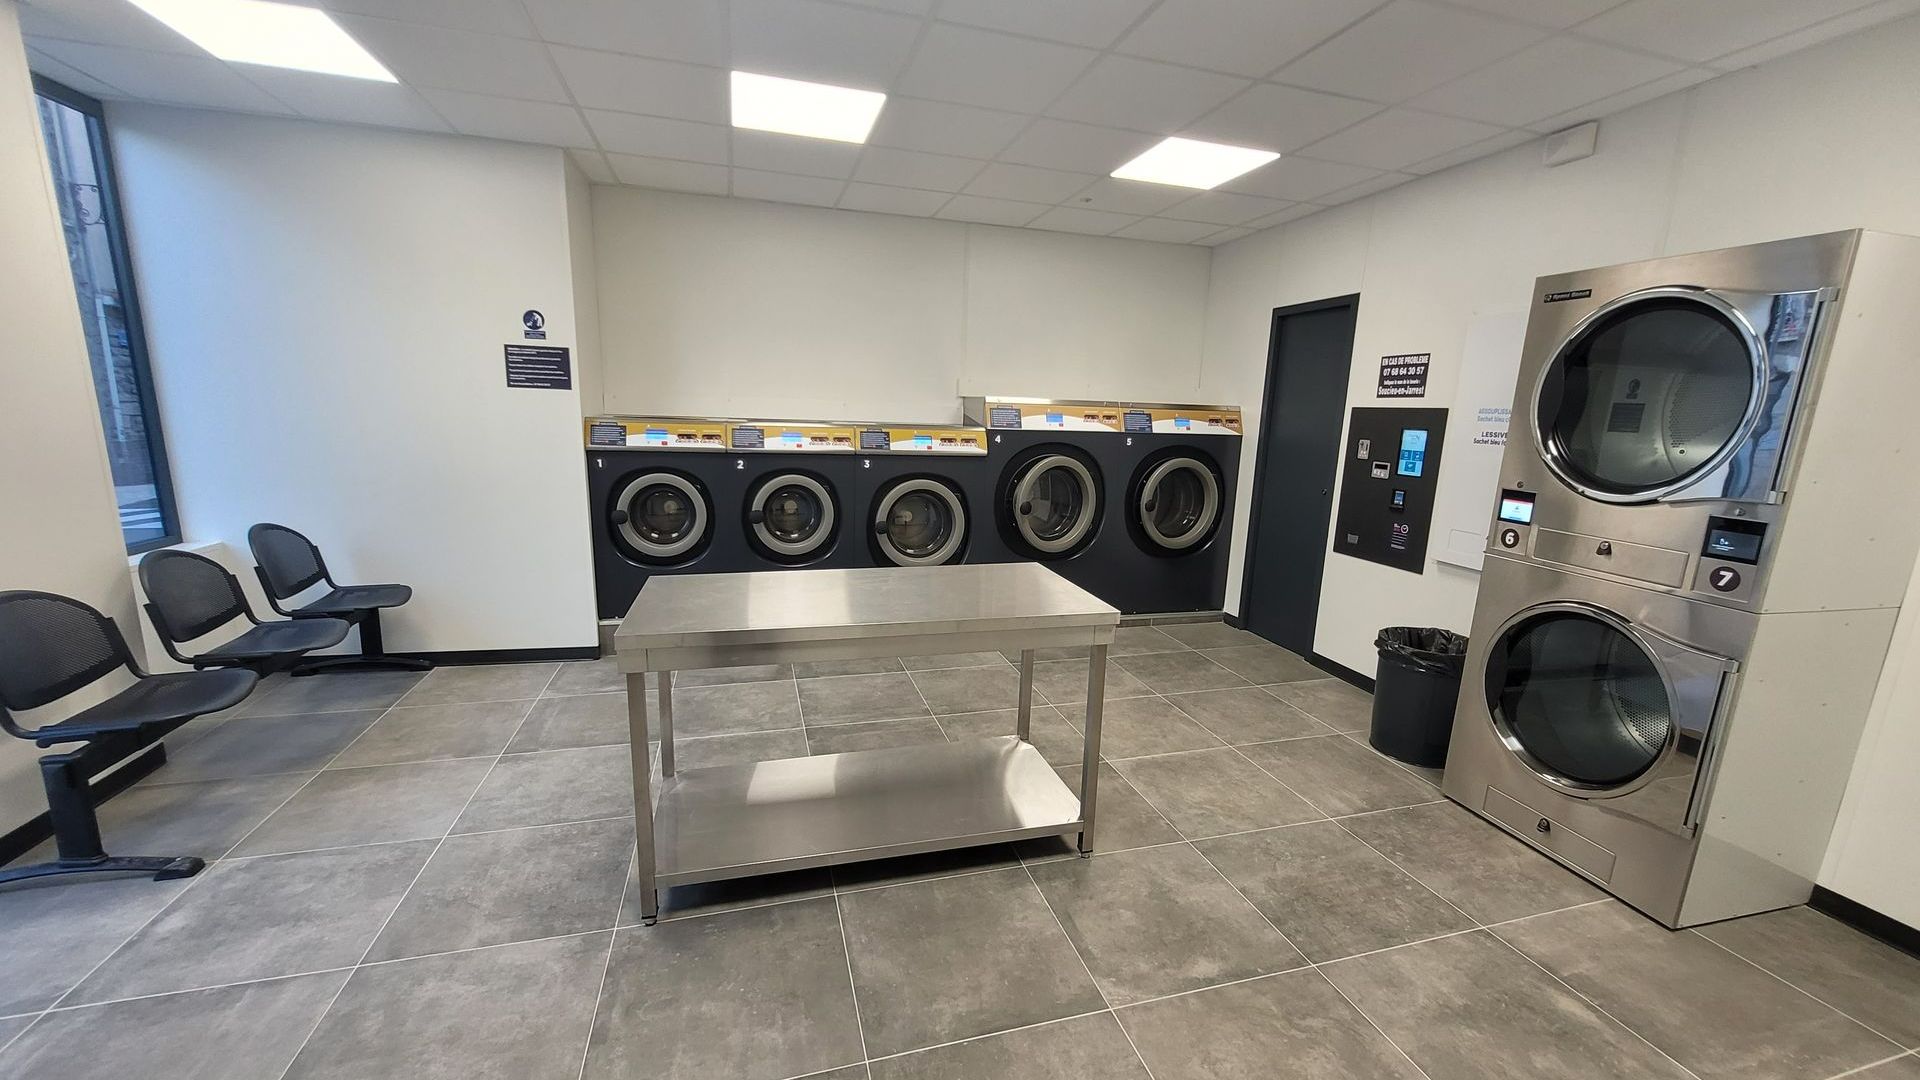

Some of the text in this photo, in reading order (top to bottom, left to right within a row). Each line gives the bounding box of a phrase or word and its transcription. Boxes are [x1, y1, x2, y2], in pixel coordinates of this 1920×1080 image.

[1383, 368, 1391, 376] 07
[1399, 367, 1407, 375] 64
[1408, 367, 1416, 375] 30
[1416, 366, 1425, 375] 57
[994, 434, 1001, 444] 4
[1126, 437, 1132, 446] 5
[596, 458, 602, 468] 1
[736, 460, 744, 469] 2
[863, 459, 870, 468] 3
[1505, 531, 1515, 545] 6
[1716, 570, 1734, 587] 7
